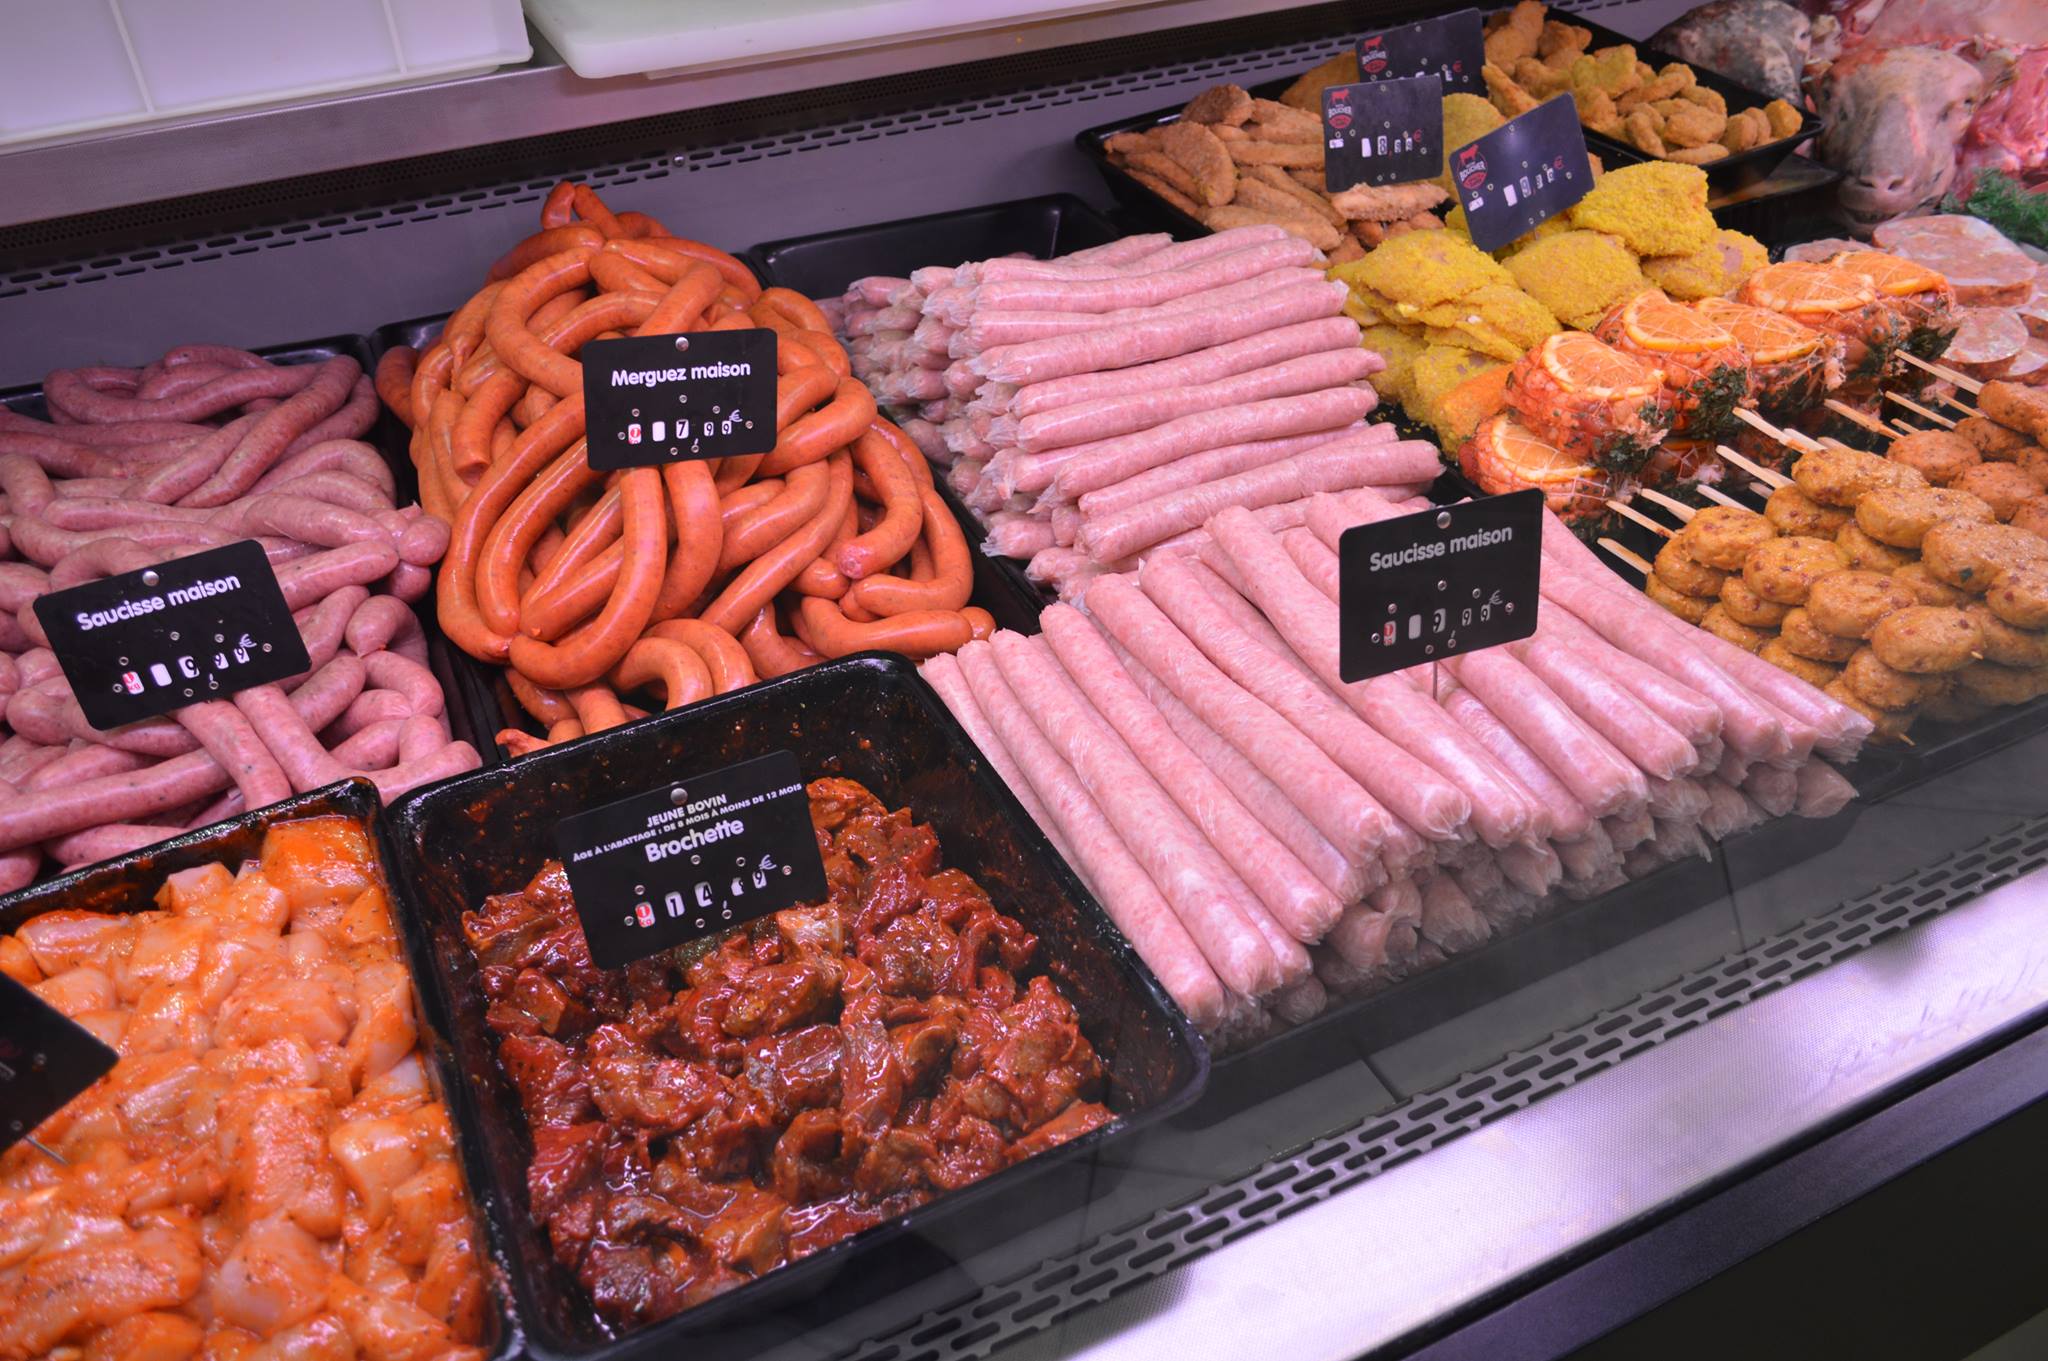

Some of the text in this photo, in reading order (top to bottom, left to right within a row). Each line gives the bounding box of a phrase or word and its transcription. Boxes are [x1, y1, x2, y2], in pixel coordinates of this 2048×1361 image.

[1328, 105, 1352, 118] BOUCHER
[1459, 160, 1486, 182] BOUCHER
[612, 361, 750, 387] Merguez maison
[1370, 527, 1512, 571] Saucisse maison
[77, 576, 240, 630] Saucisse maison
[595, 845, 604, 856] À
[604, 829, 657, 852] L'ABATTAGE
[664, 822, 676, 833] DE
[686, 812, 710, 826] MOIS
[720, 800, 751, 815] MOINS
[752, 795, 765, 804] DE
[766, 790, 778, 800] 12
[779, 783, 802, 797] MOIS
[647, 794, 727, 828] JEUNE BOVIN
[645, 819, 745, 863] Brochette
